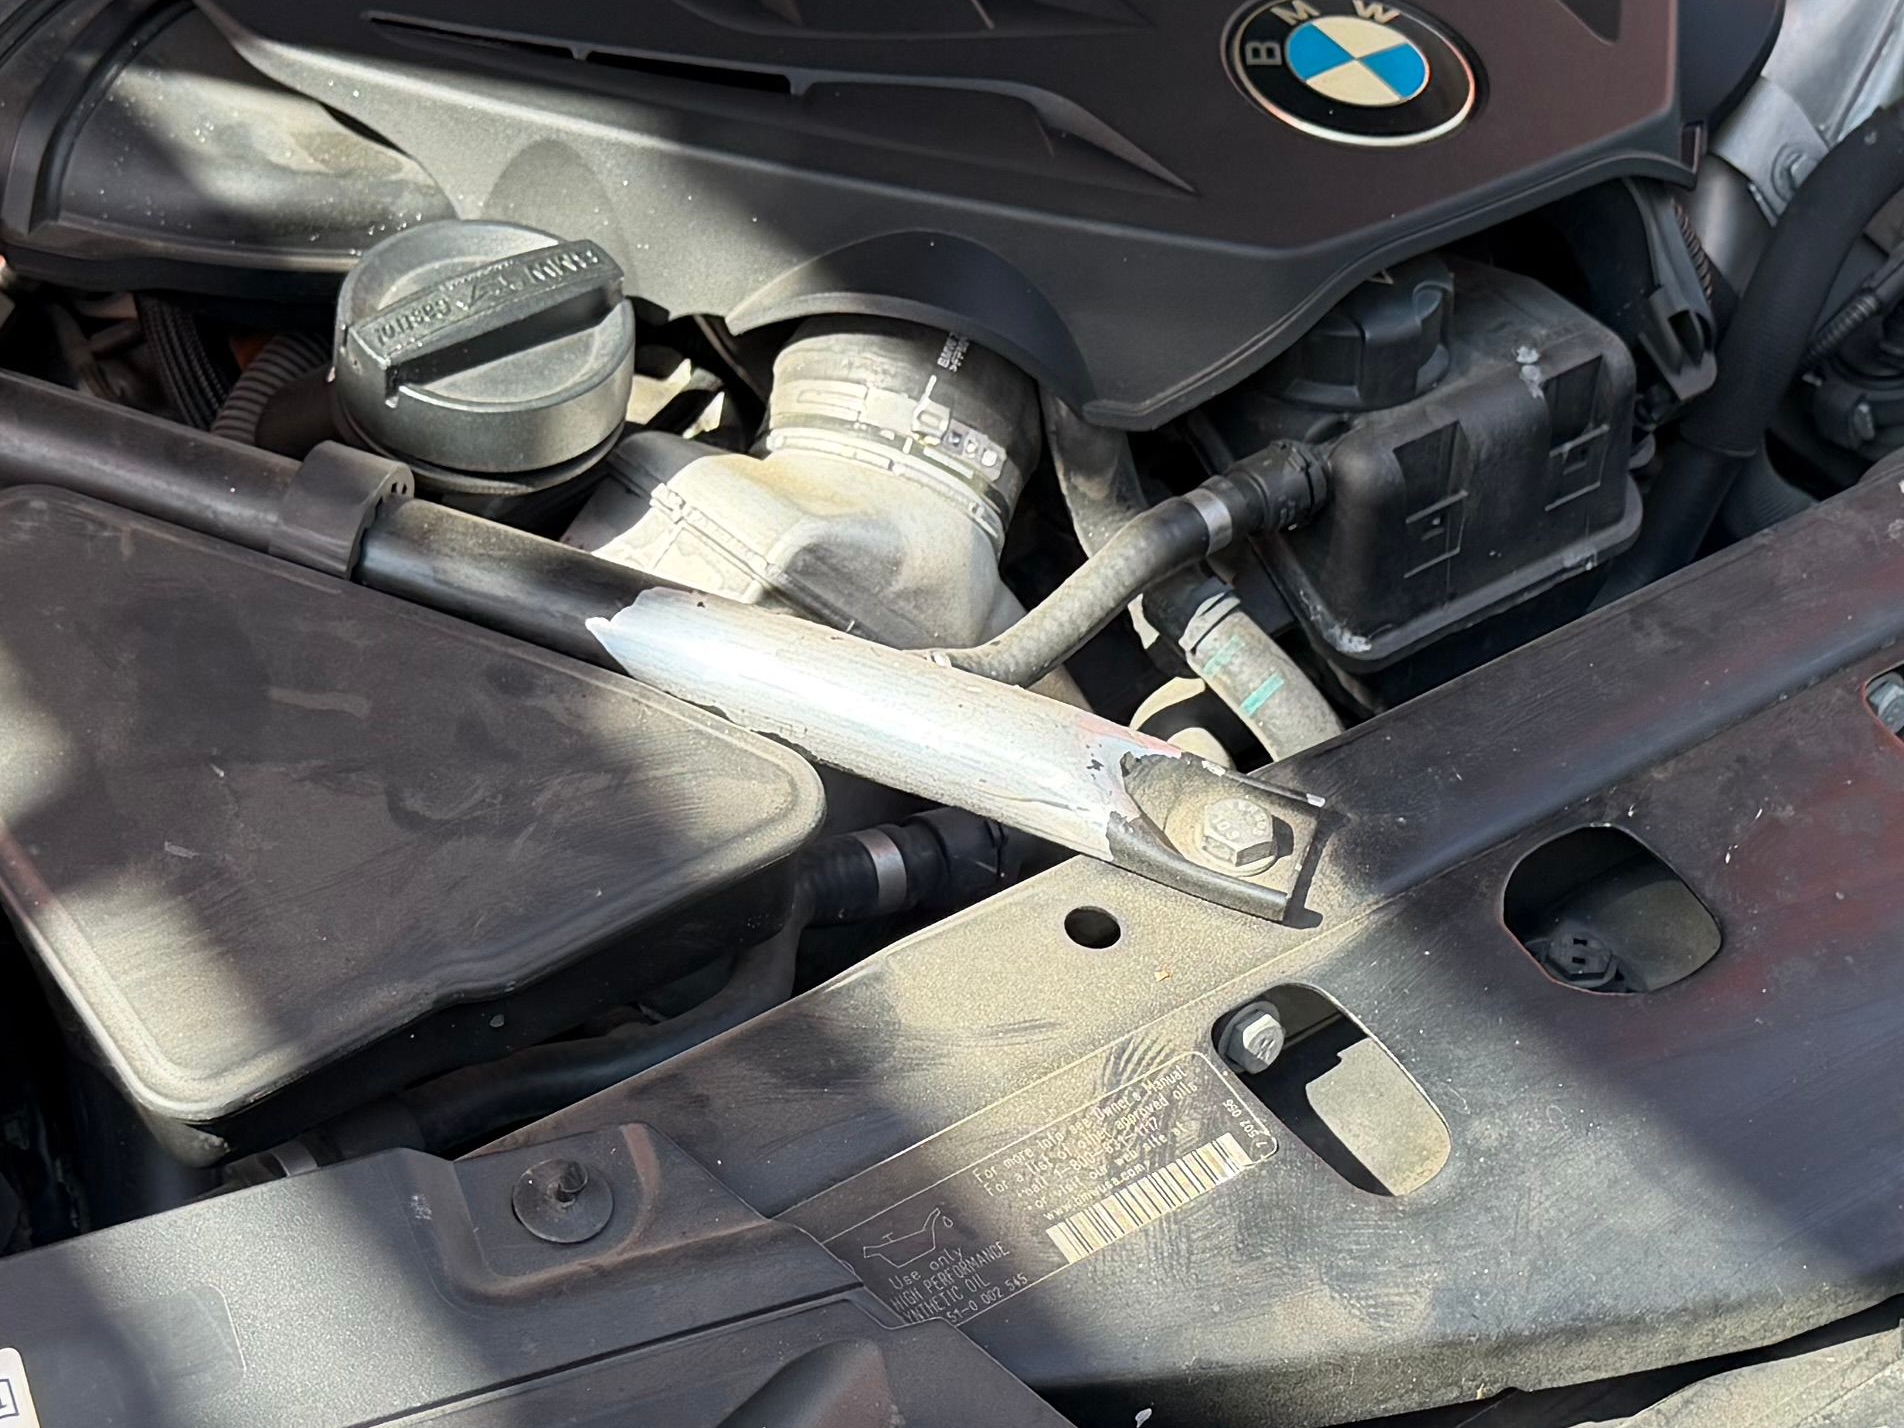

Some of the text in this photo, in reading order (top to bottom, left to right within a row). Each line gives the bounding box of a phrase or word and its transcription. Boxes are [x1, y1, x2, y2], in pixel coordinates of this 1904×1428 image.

[971, 1165, 998, 1183] For
[1002, 1147, 1034, 1169] more
[1141, 1064, 1187, 1095] Manual
[982, 1179, 1009, 1197] For
[1113, 1092, 1169, 1129] approved
[888, 1247, 963, 1290] Use only
[889, 1240, 1010, 1311] HIGH PERFORMANCE
[903, 1272, 990, 1323] YNTHETIC OIL
